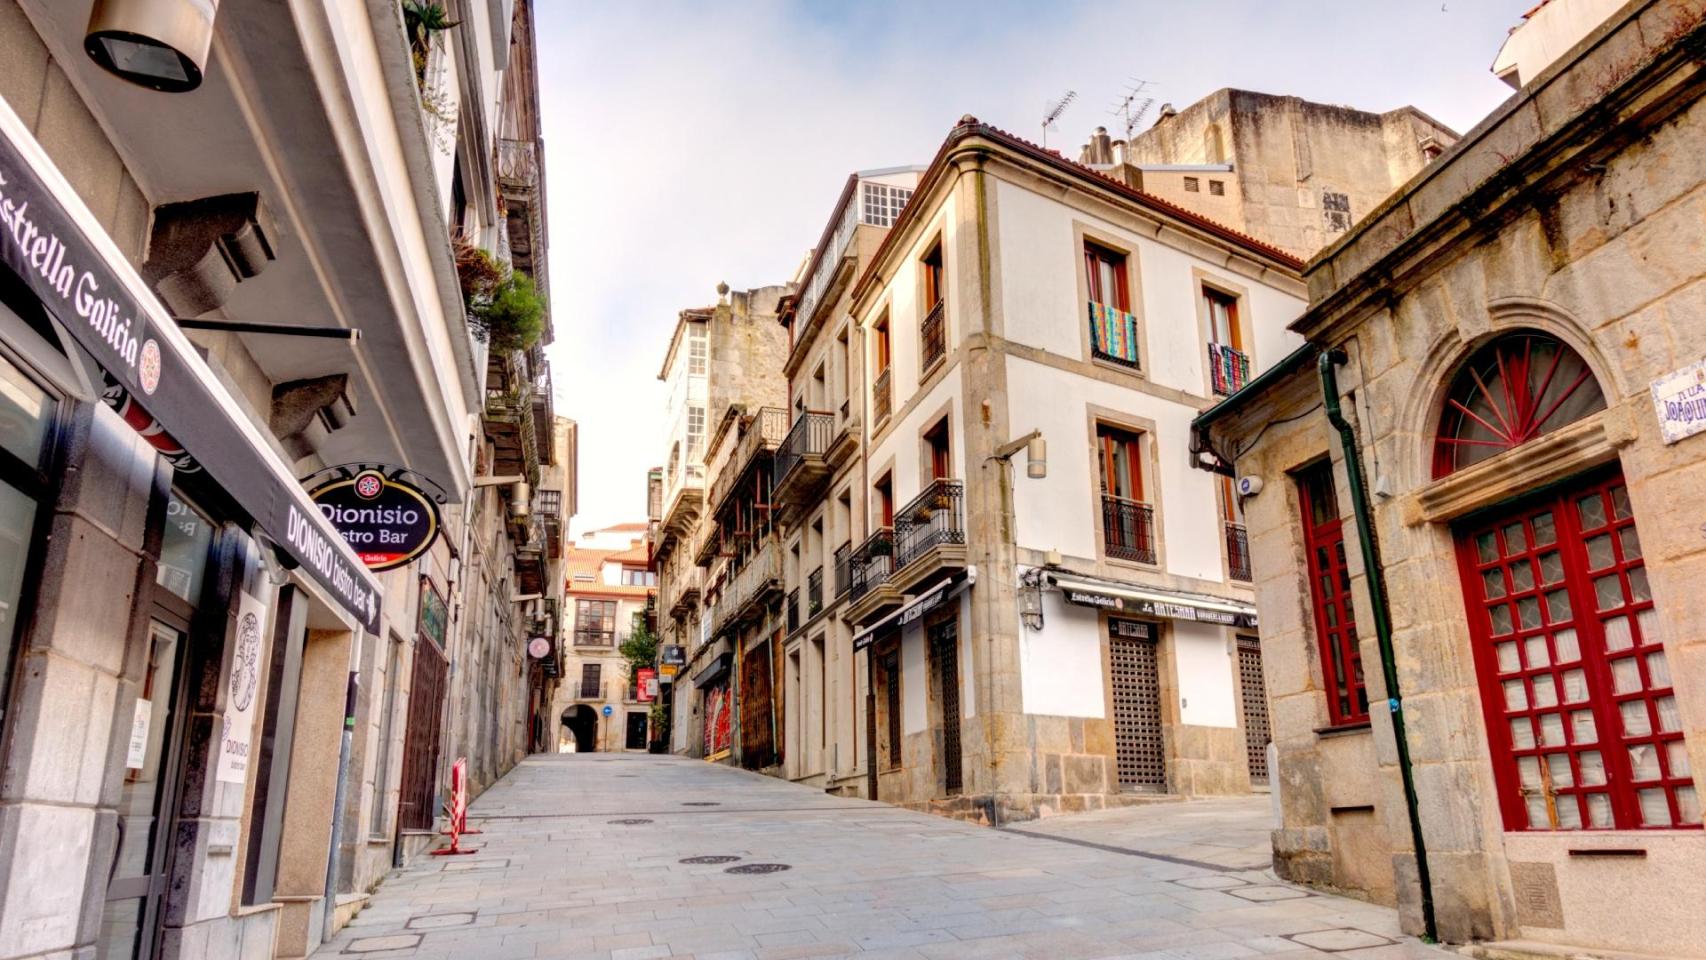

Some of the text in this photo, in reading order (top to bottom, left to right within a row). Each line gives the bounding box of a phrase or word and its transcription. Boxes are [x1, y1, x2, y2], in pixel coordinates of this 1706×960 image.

[0, 171, 138, 367] strella Galicia
[1664, 398, 1706, 424] JOAQUI
[318, 503, 419, 525] Dionisio
[336, 529, 408, 544] stro Bar
[287, 504, 367, 613] DIONISIO bistro bar
